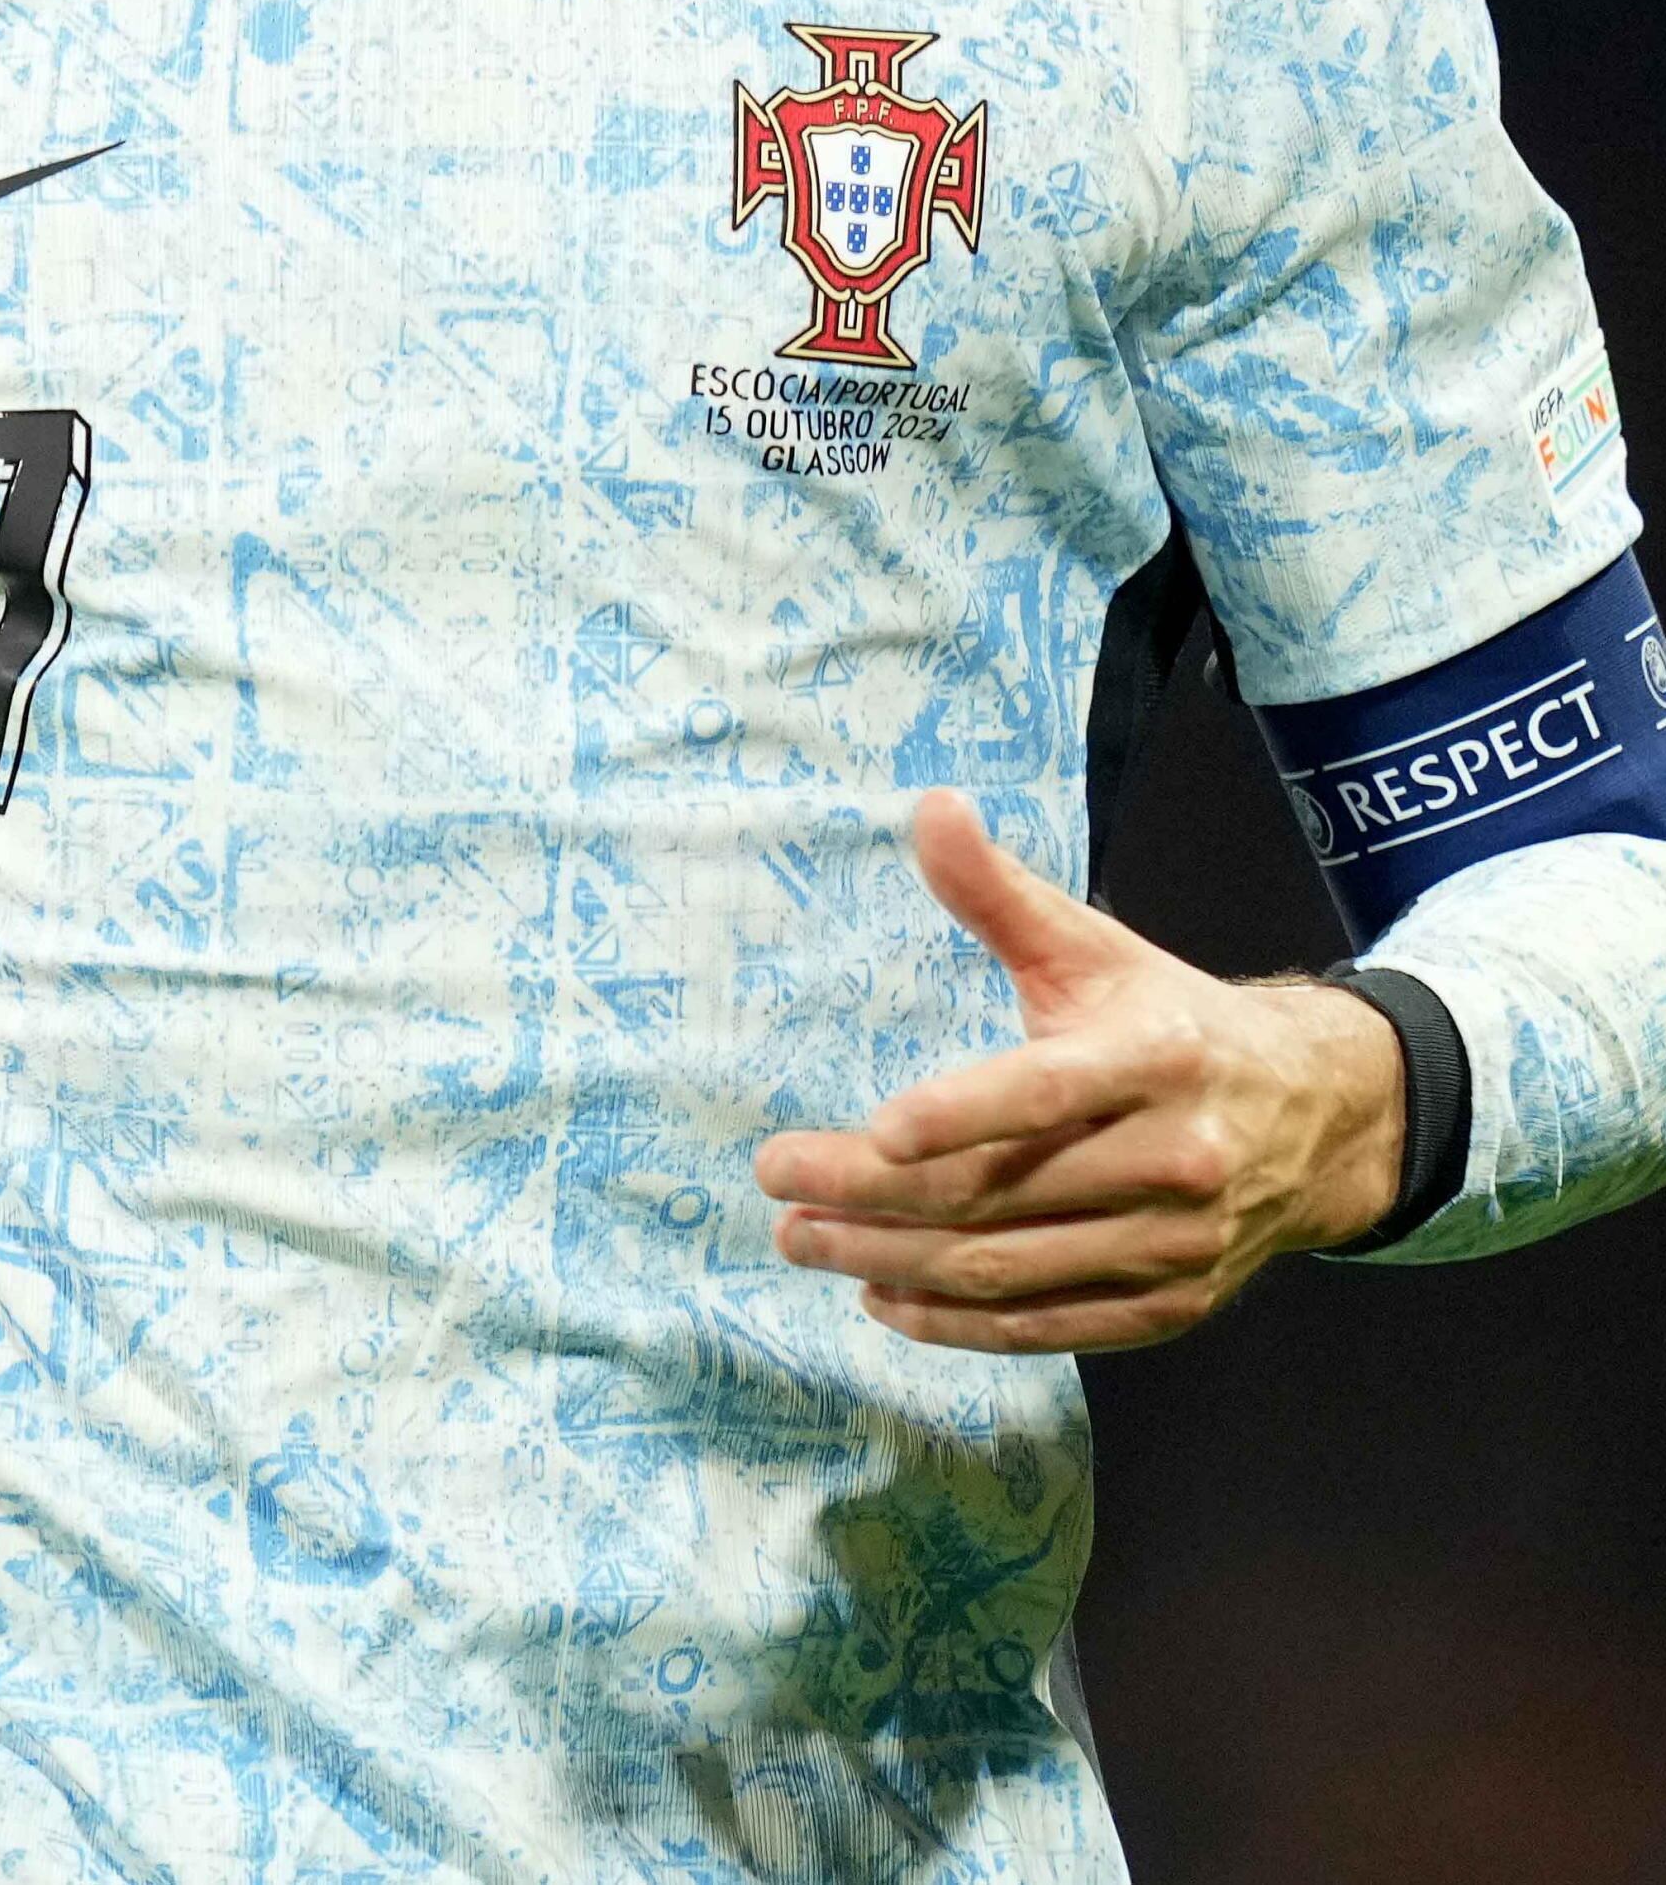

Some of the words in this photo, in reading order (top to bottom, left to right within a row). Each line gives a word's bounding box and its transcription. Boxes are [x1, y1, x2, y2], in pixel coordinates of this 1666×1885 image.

[833, 98, 893, 125] F.P.F.
[706, 405, 732, 436] 15
[746, 409, 874, 441] OUTUBRO
[882, 413, 952, 443] 2024
[1529, 386, 1565, 434] UEFA
[761, 442, 891, 477] GLASGOW
[1337, 680, 1602, 833] RESPECT
